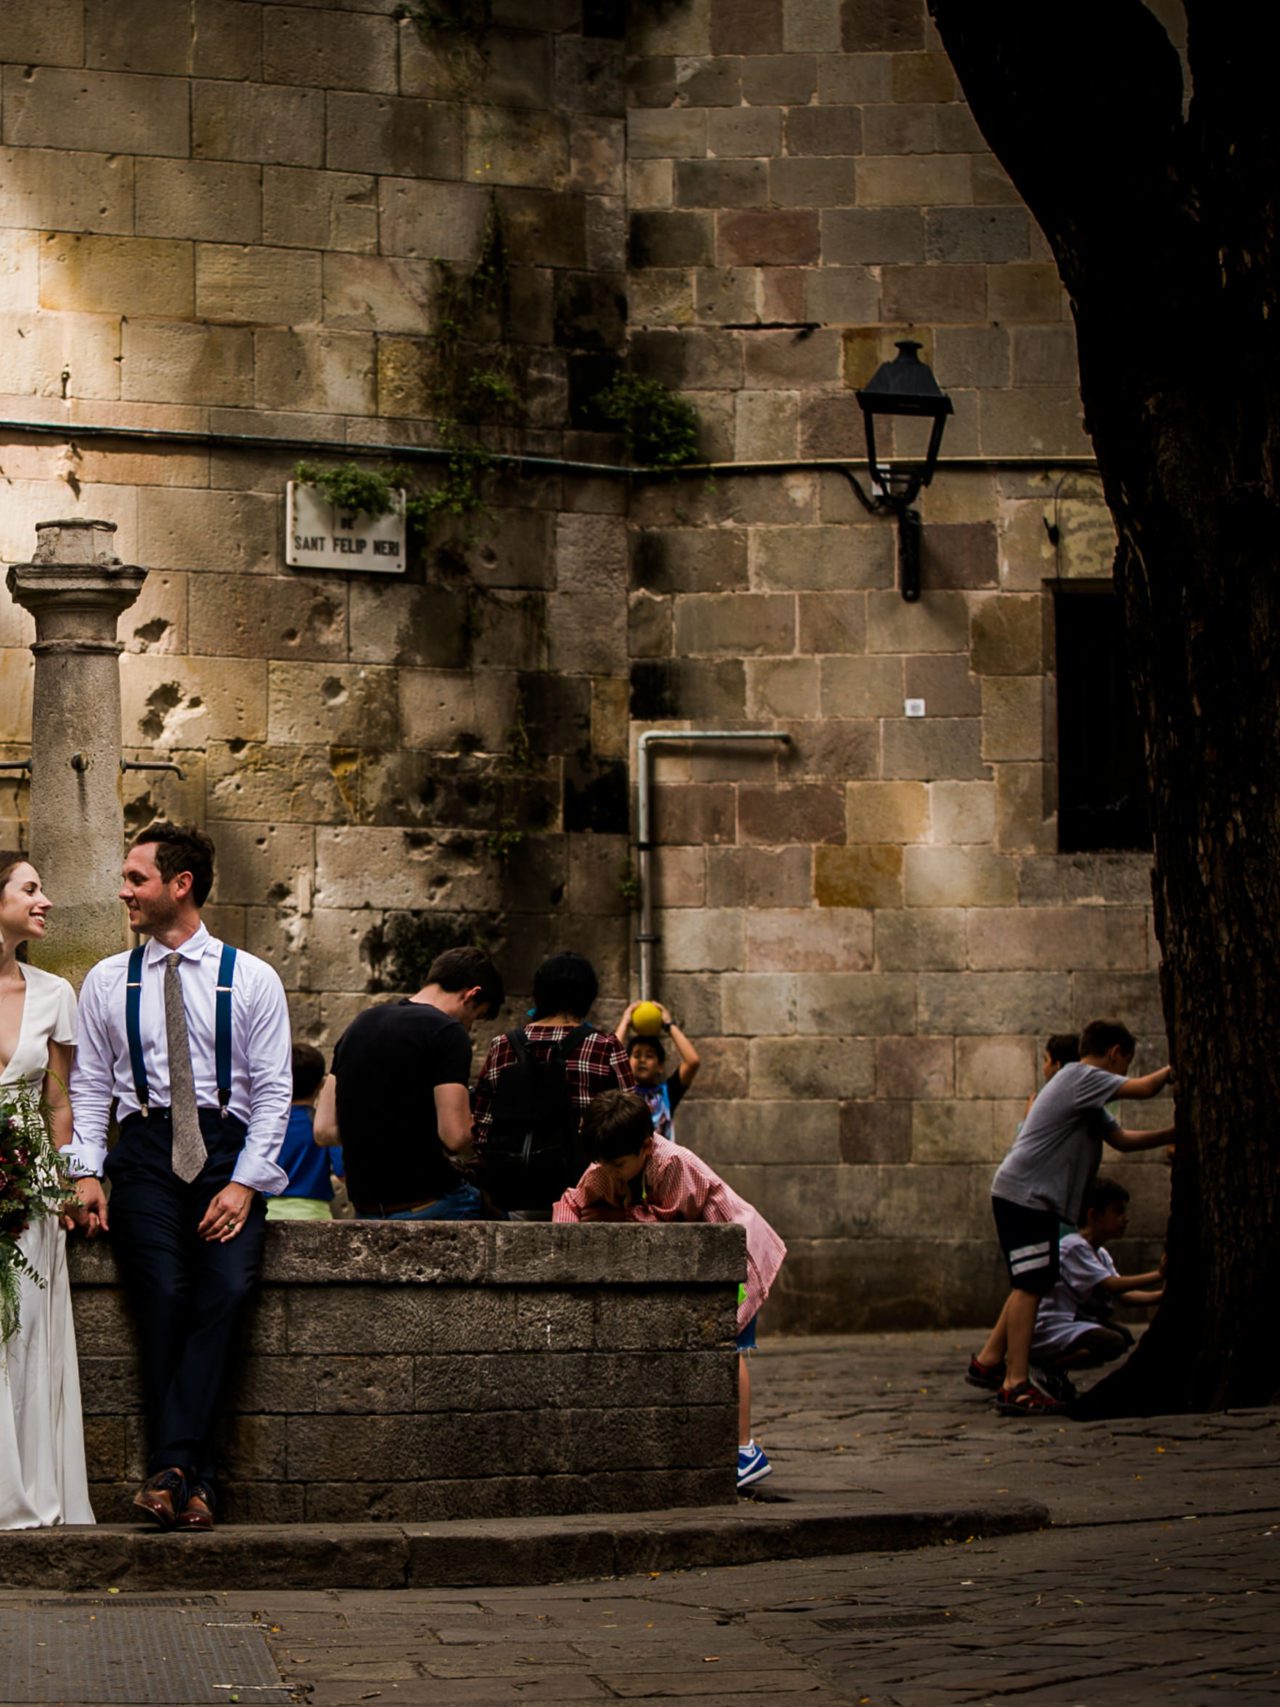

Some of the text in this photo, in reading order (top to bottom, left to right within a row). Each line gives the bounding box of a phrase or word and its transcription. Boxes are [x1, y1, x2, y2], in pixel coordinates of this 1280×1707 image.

[341, 517, 354, 530] DE
[294, 535, 400, 557] SANT FELIP NERI
